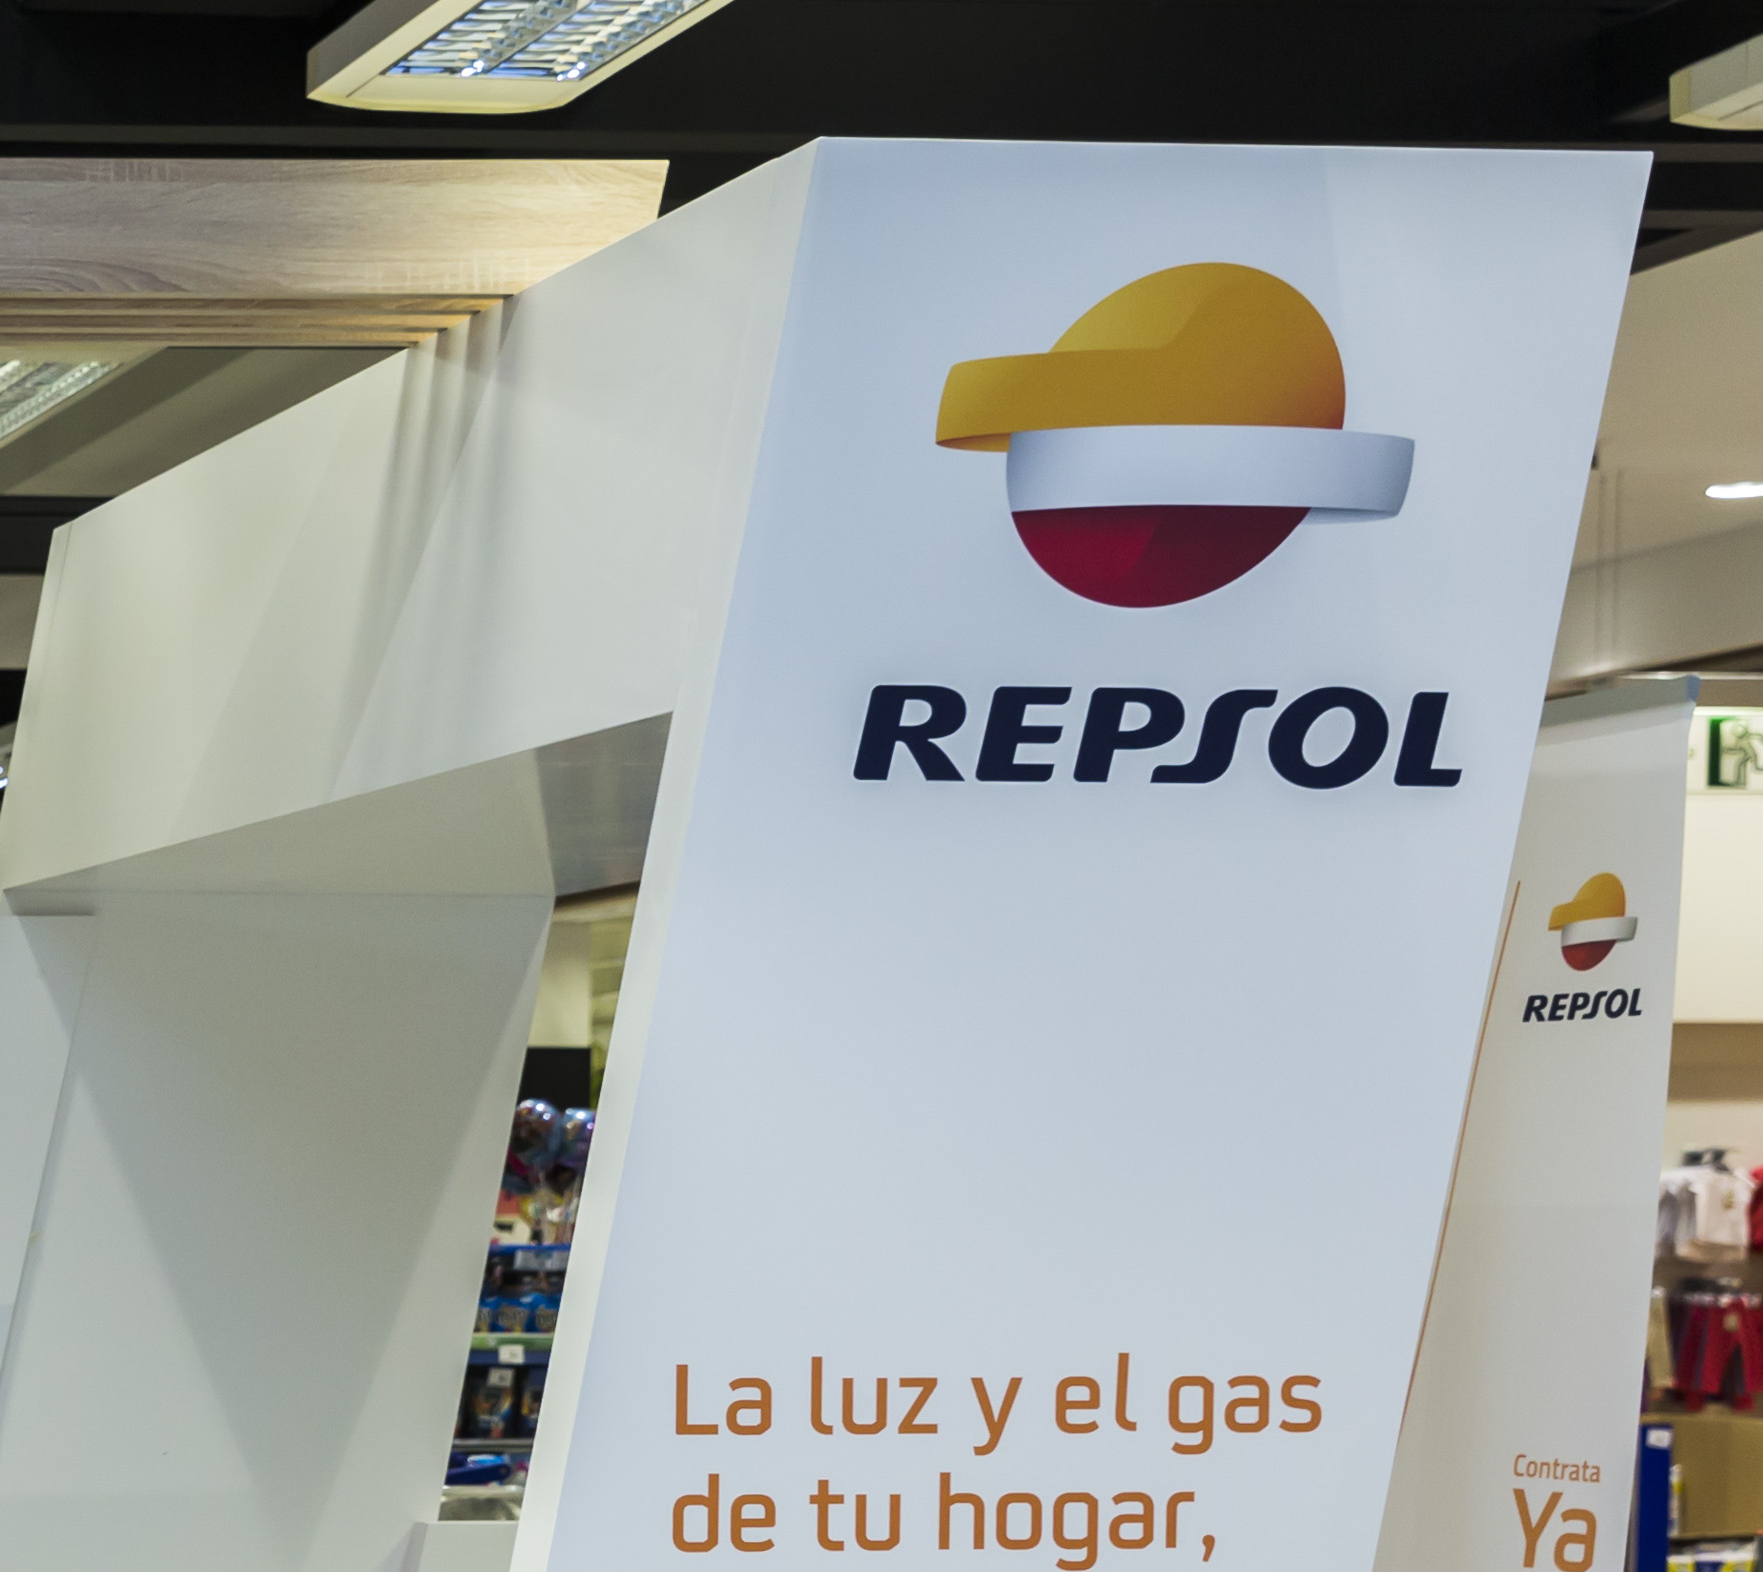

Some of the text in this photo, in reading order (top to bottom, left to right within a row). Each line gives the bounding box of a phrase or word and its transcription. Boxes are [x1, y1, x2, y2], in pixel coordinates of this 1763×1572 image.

[853, 685, 1463, 790] REPSOL
[1522, 988, 1643, 1023] REPSOL
[674, 1352, 1323, 1456] La luz y el gas
[1513, 1453, 1601, 1483] Contrata
[672, 1471, 1216, 1571] de tu hogar,
